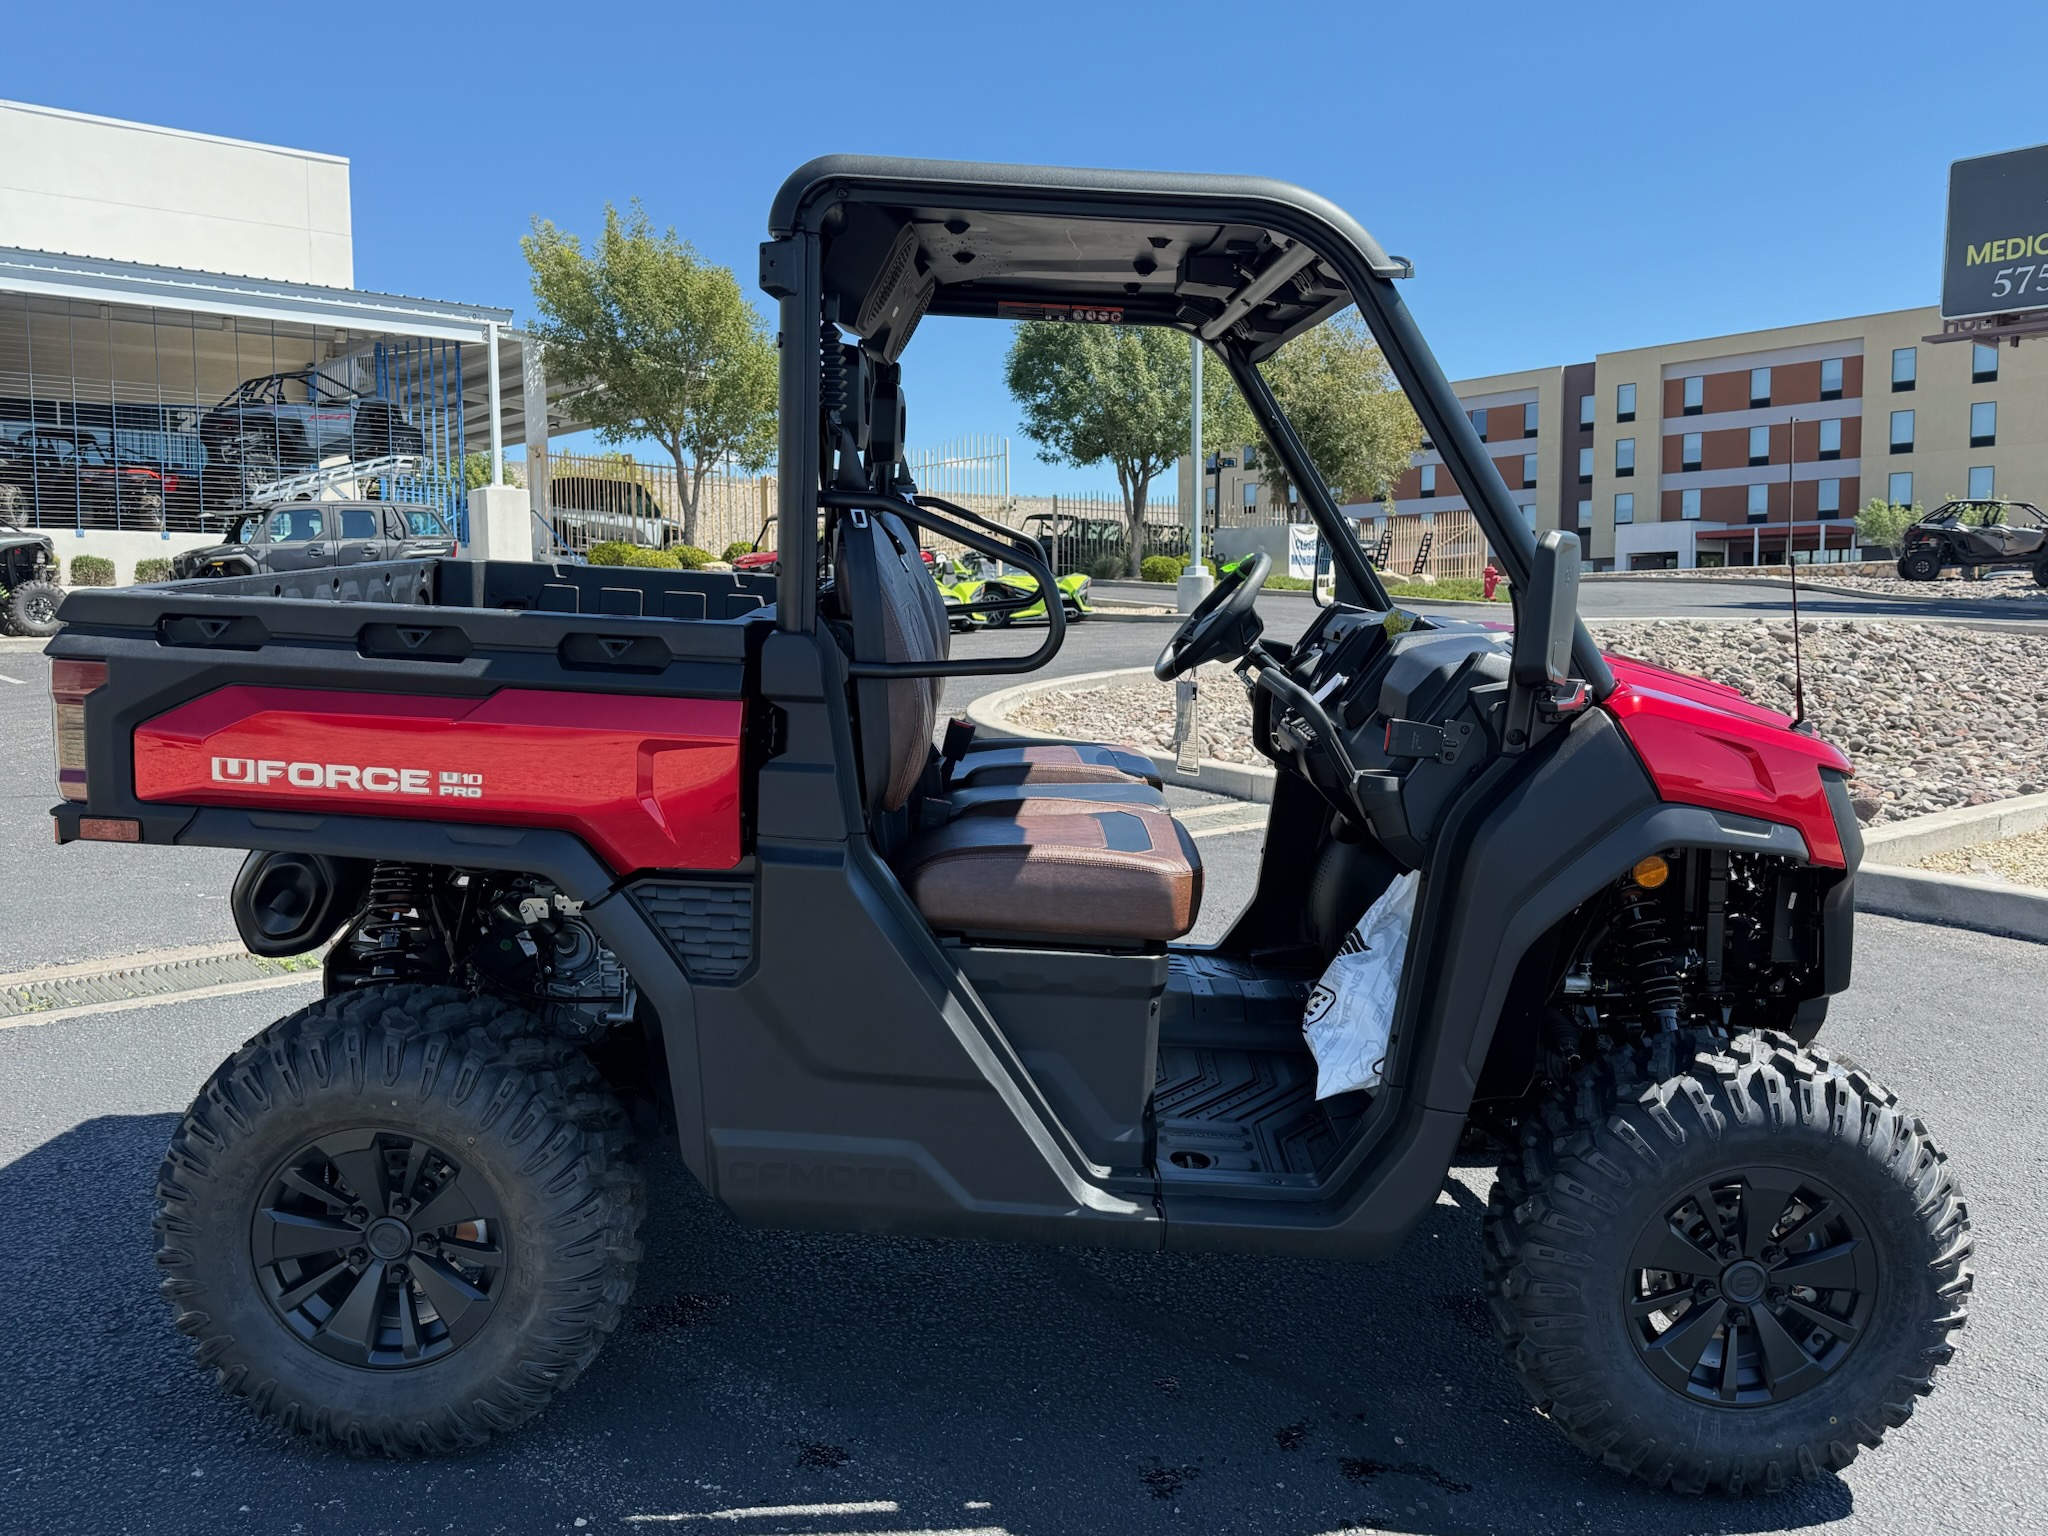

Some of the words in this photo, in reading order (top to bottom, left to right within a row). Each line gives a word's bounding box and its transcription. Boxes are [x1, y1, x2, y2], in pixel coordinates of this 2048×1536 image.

[1966, 232, 2048, 267] MEDIC
[1992, 264, 2048, 297] 575
[439, 771, 483, 785] U10
[439, 785, 483, 798] PRO
[728, 1160, 919, 1192] CFMOTO
